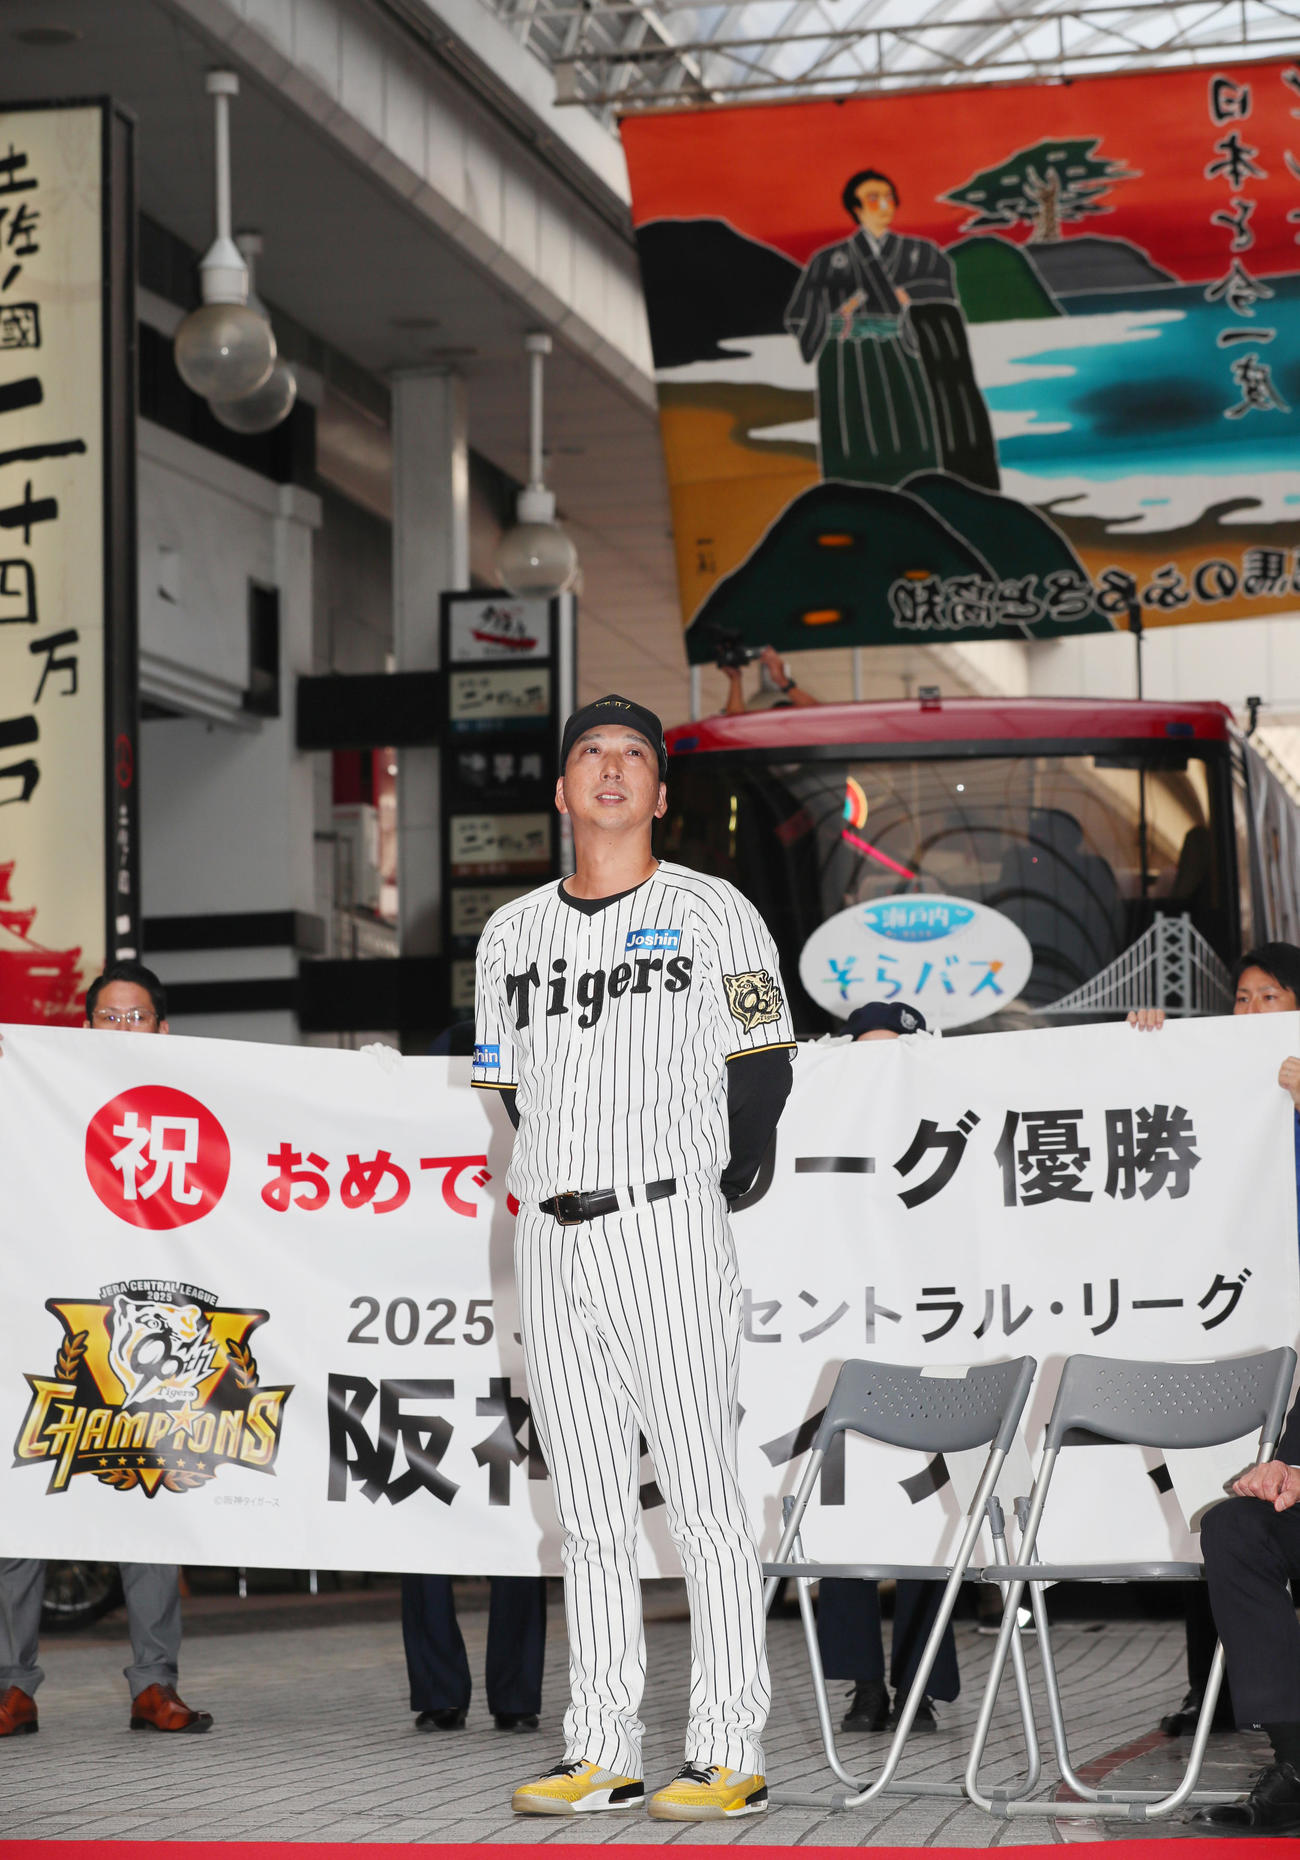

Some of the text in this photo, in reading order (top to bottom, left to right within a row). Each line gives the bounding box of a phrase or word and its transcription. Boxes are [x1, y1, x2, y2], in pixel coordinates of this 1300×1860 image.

[626, 932, 678, 948] Joshin
[506, 955, 694, 1031] Tigers
[822, 954, 1005, 1000] そらバス
[110, 1111, 203, 1206] 祝
[260, 1141, 519, 1218] おめで
[99, 1280, 217, 1306] JERA CENTRAL LEAGUE
[146, 1291, 172, 1302] 2025
[347, 1268, 1253, 1346] 2025 セントラル・リーグ
[157, 1387, 195, 1398] Tigers
[18, 1379, 285, 1488] CHAMPIONS
